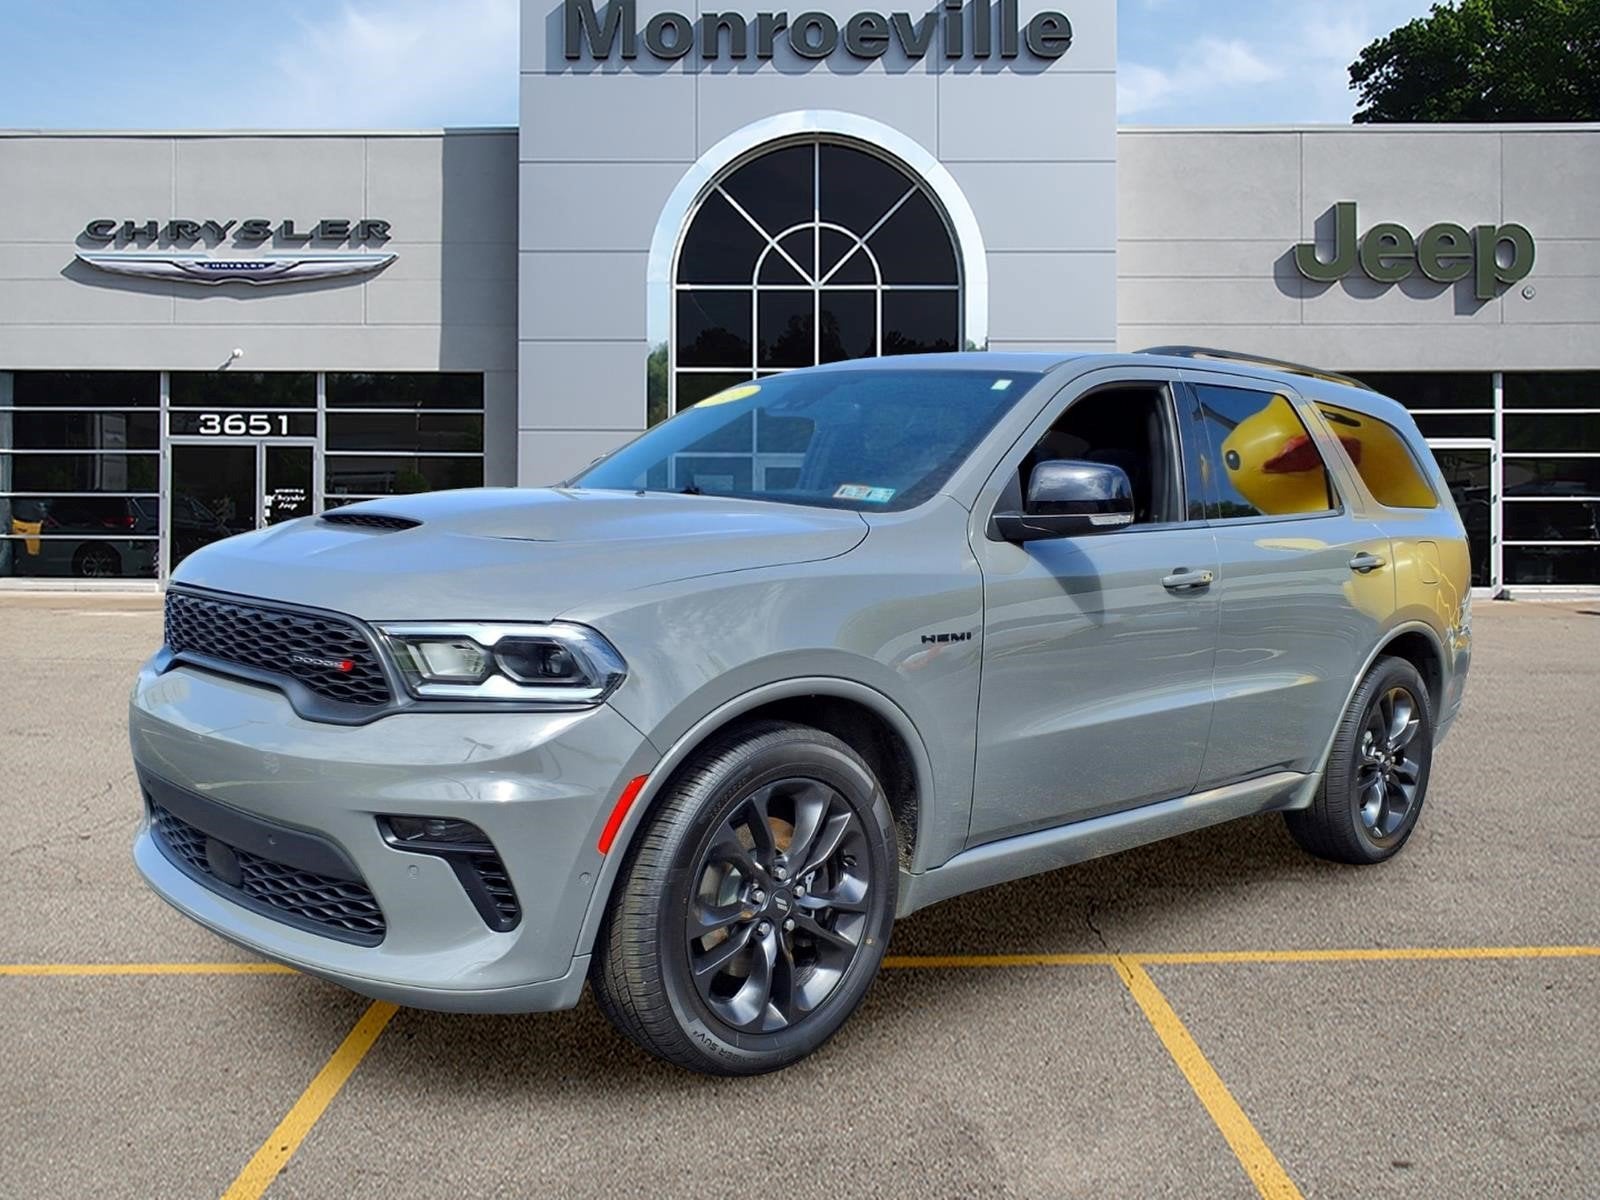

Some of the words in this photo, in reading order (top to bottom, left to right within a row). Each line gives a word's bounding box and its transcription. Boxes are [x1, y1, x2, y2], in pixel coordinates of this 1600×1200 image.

[563, 0, 1073, 59] Monroeville
[85, 219, 392, 241] CHRYSLER
[1295, 202, 1535, 299] Jeep
[199, 414, 288, 435] 3651
[921, 632, 972, 644] HEMI
